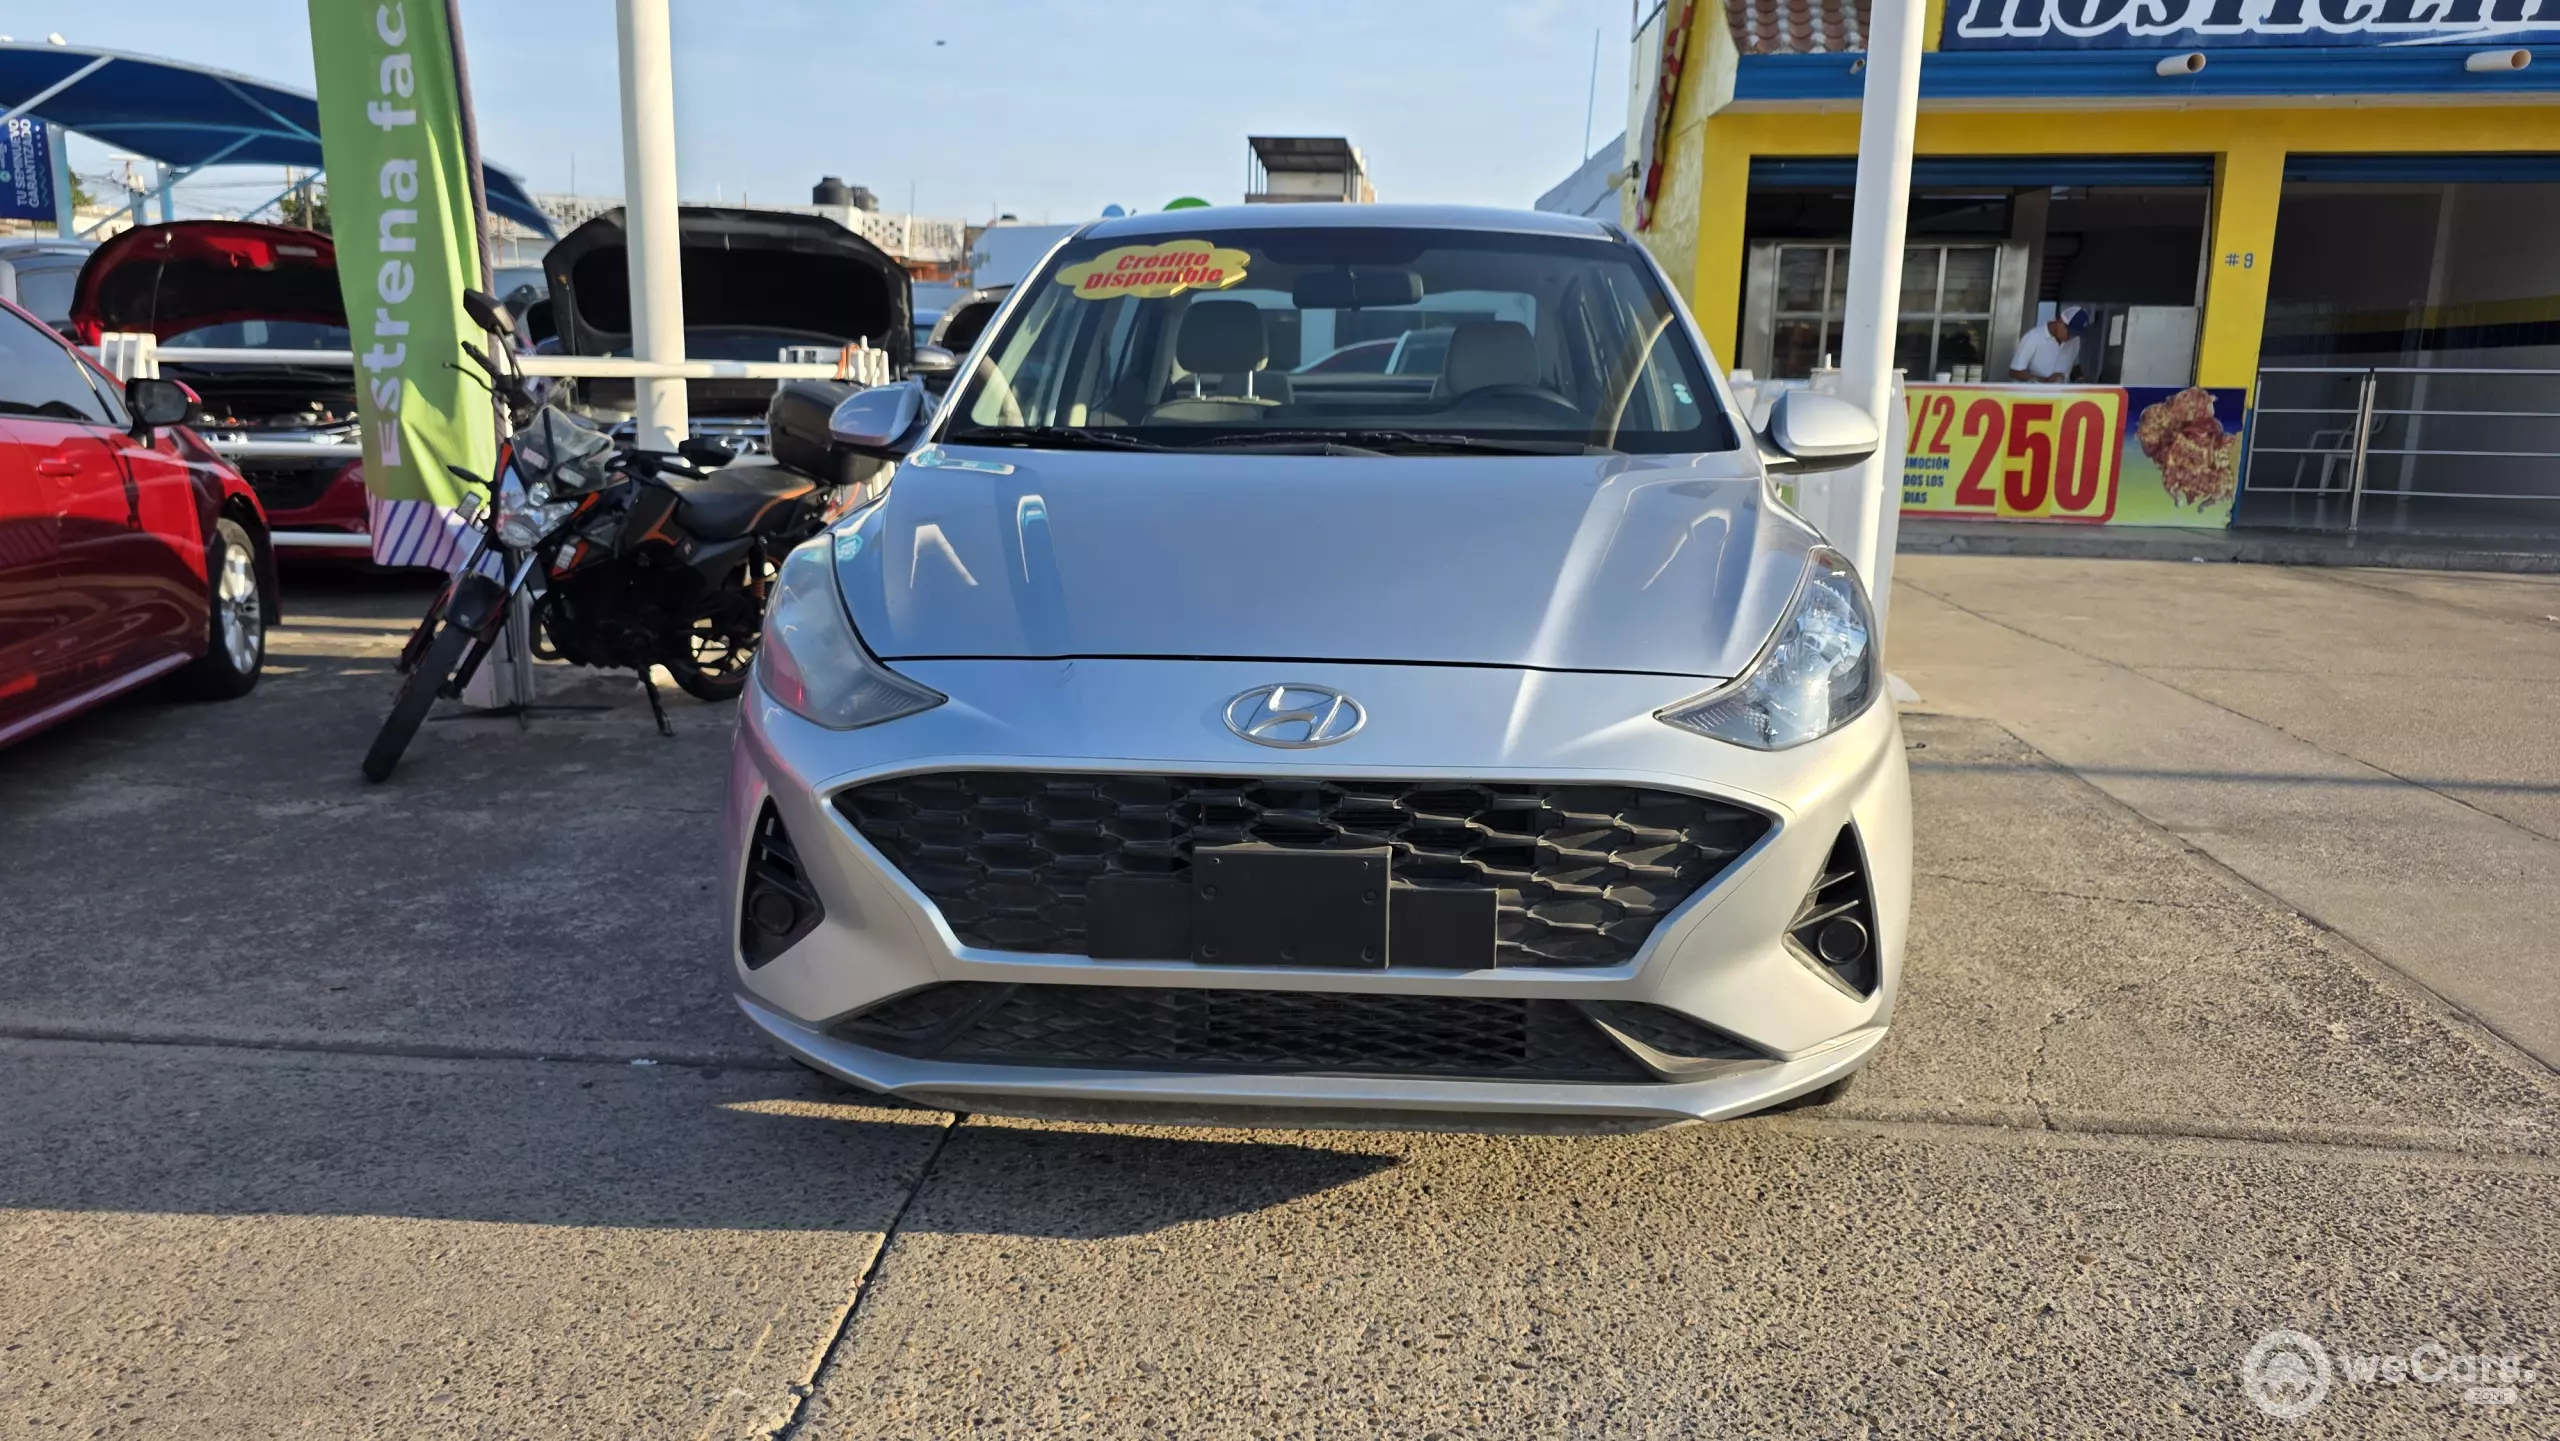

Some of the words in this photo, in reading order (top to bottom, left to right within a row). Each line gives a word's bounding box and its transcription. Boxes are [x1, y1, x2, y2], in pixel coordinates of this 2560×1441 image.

[367, 0, 417, 132] fac
[362, 158, 419, 467] Estrena
[1083, 267, 1223, 289] Disponible
[1926, 475, 1944, 487] LOS
[1955, 398, 2106, 512] 250
